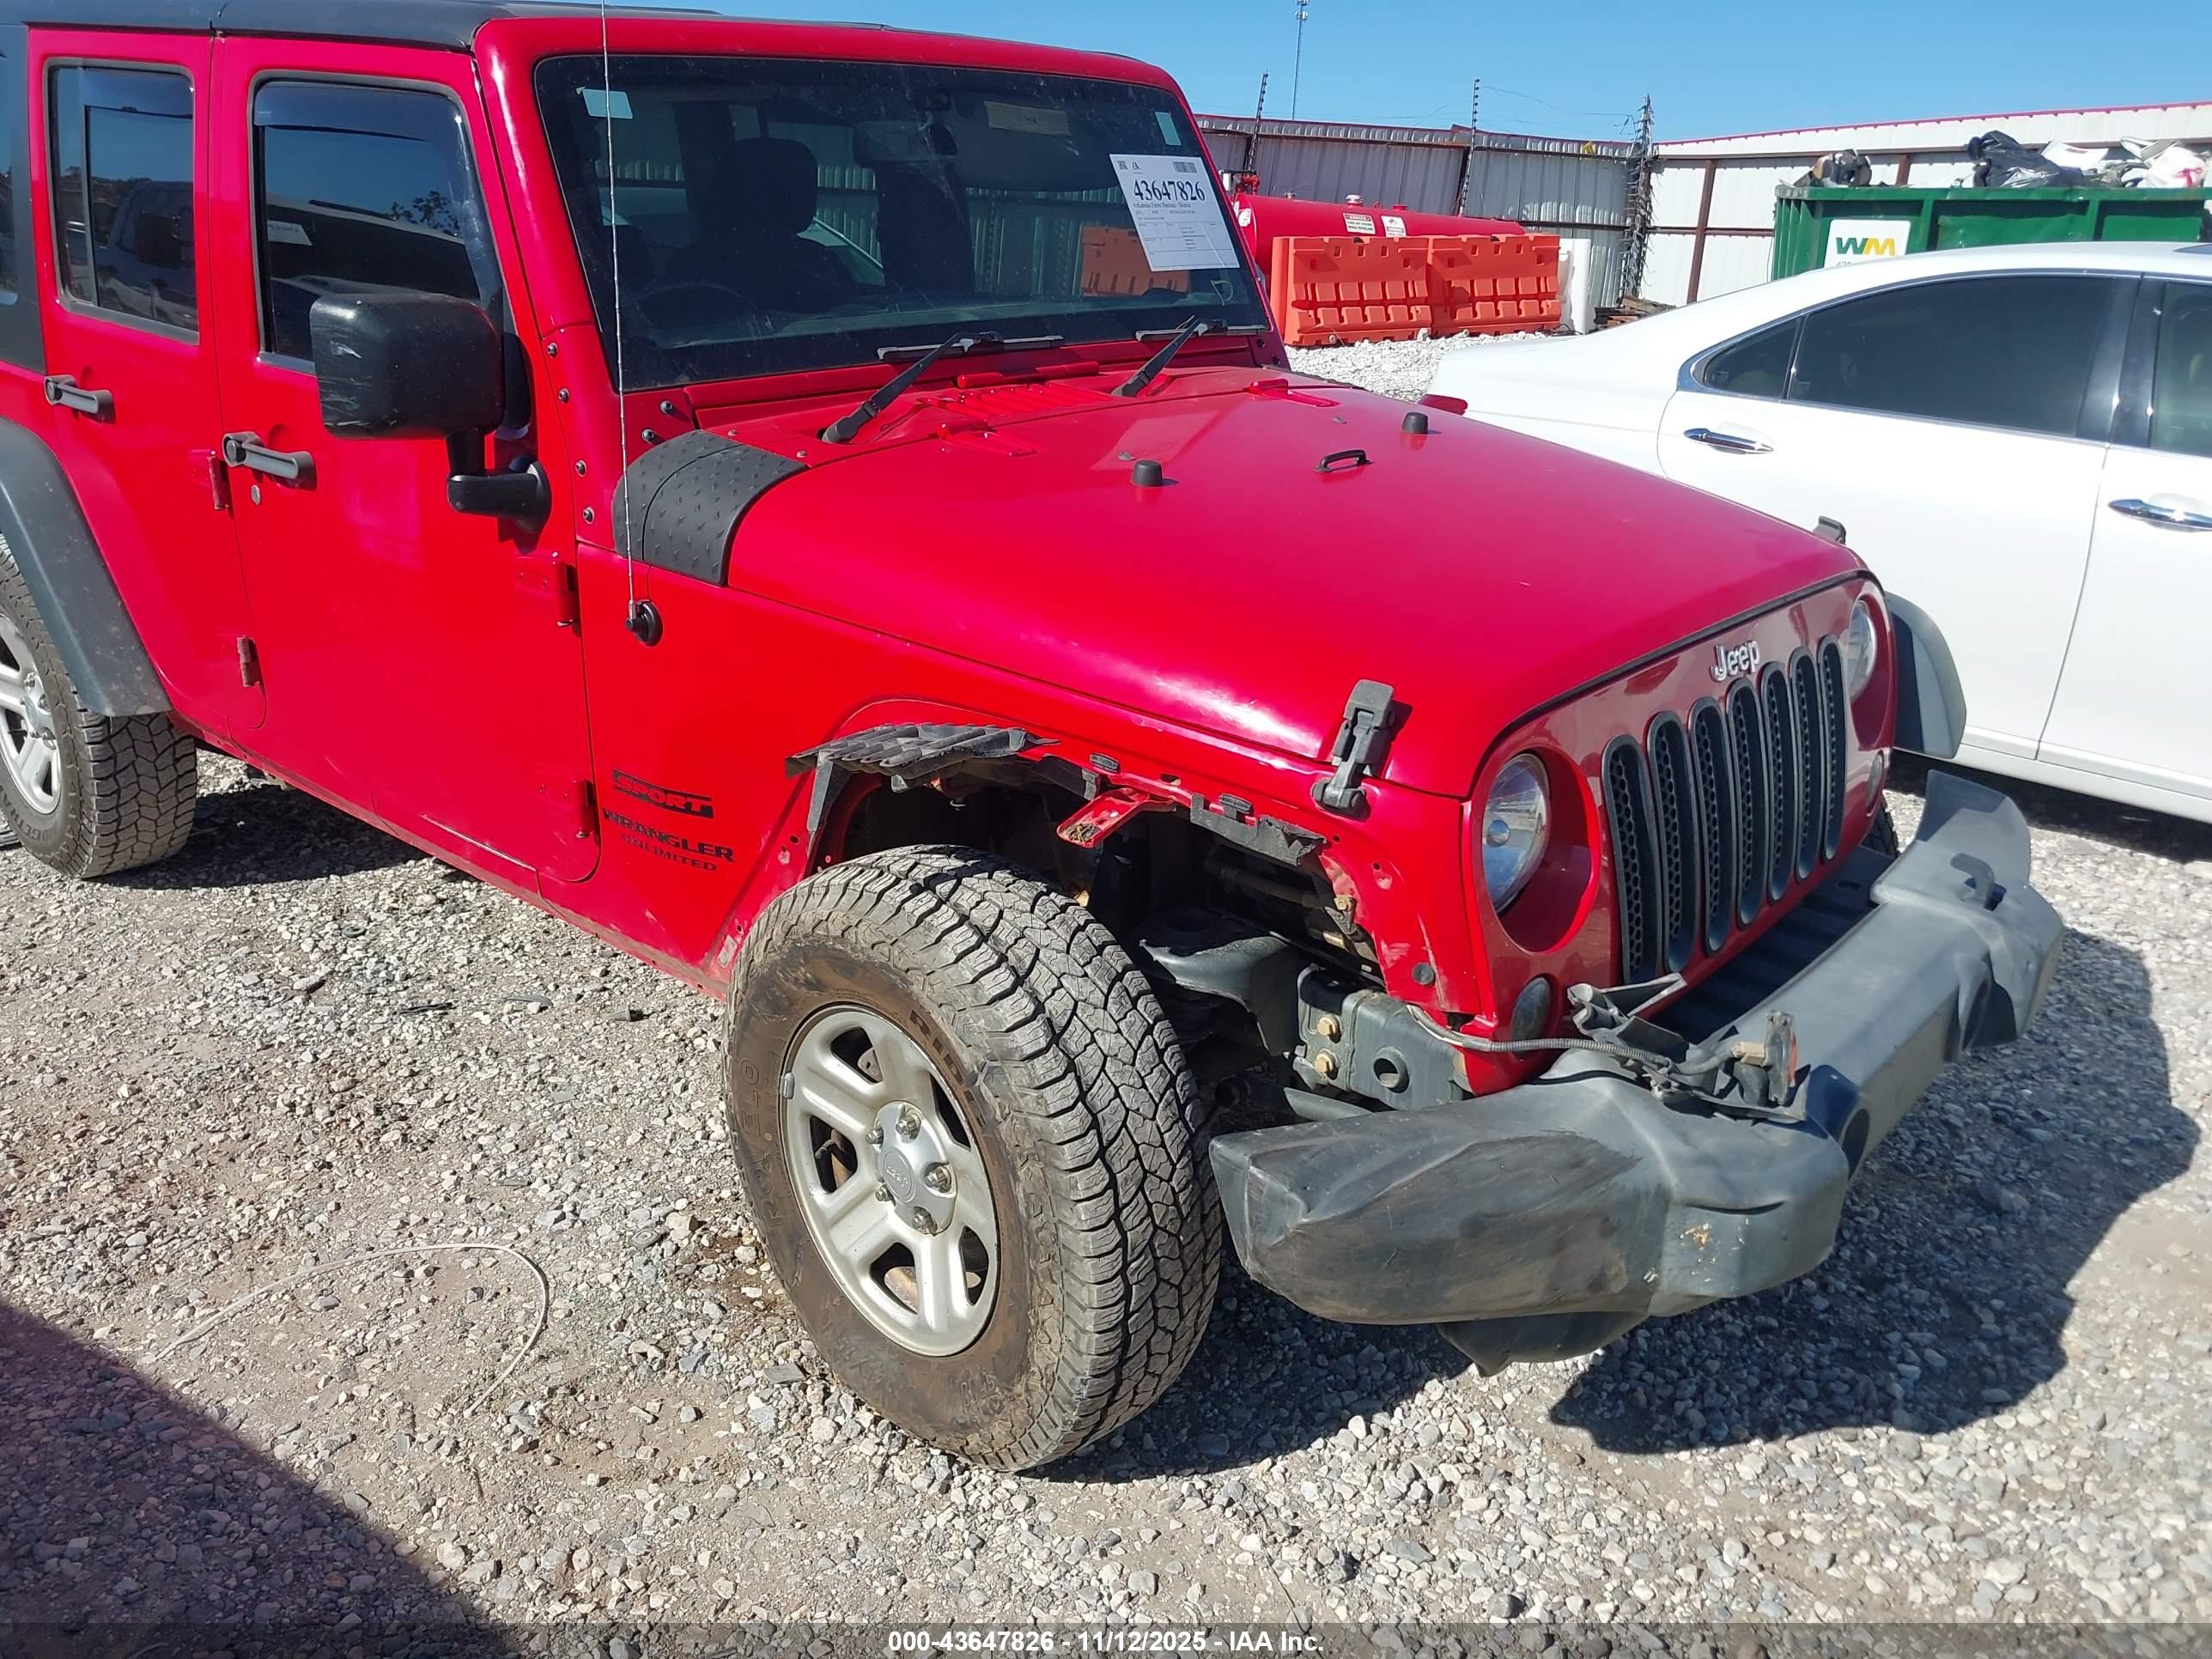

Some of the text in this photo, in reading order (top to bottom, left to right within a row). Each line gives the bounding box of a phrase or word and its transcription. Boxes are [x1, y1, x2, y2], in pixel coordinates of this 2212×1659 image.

[1133, 179, 1206, 201] 43647826
[1835, 237, 1896, 257] WM
[1709, 640, 1760, 683] Jeep
[615, 773, 714, 815] SPORT
[602, 806, 735, 863] WRANGLER
[622, 833, 718, 872] UNLIMITED
